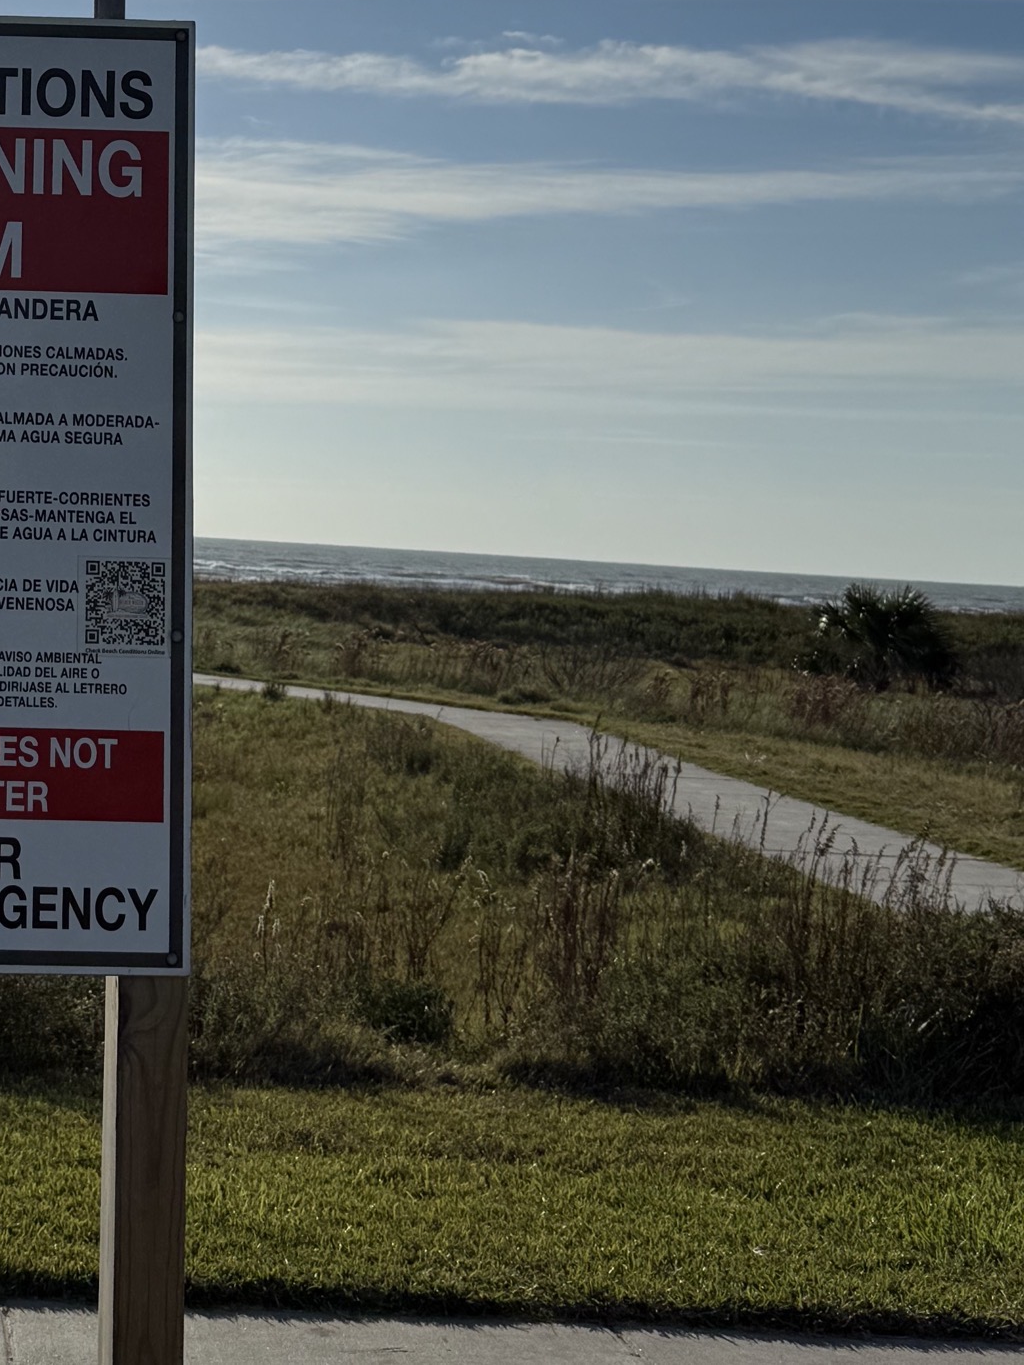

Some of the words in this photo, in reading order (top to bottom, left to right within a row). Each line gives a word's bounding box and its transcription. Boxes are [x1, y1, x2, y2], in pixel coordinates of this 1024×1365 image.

[46, 346, 127, 361] CALMADAS.
[21, 362, 117, 378] PRECAUCIÓN.
[58, 414, 68, 426] A
[21, 430, 60, 443] AGUA
[65, 431, 122, 445] SEGURA
[120, 512, 136, 524] EL
[13, 527, 52, 540] AGUA
[57, 528, 66, 540] A
[71, 528, 88, 541] LA
[93, 529, 156, 543] CINTURA
[23, 579, 41, 592] DE
[46, 580, 79, 593] VIDA
[36, 652, 102, 664] AMBIENTAL
[35, 667, 57, 678] DEL
[61, 668, 87, 678] AIRE
[91, 668, 99, 679] O
[0, 681, 51, 692] DIRIJASE
[55, 683, 69, 693] AL
[74, 683, 127, 695] LETRERO
[50, 737, 118, 768] NOT
